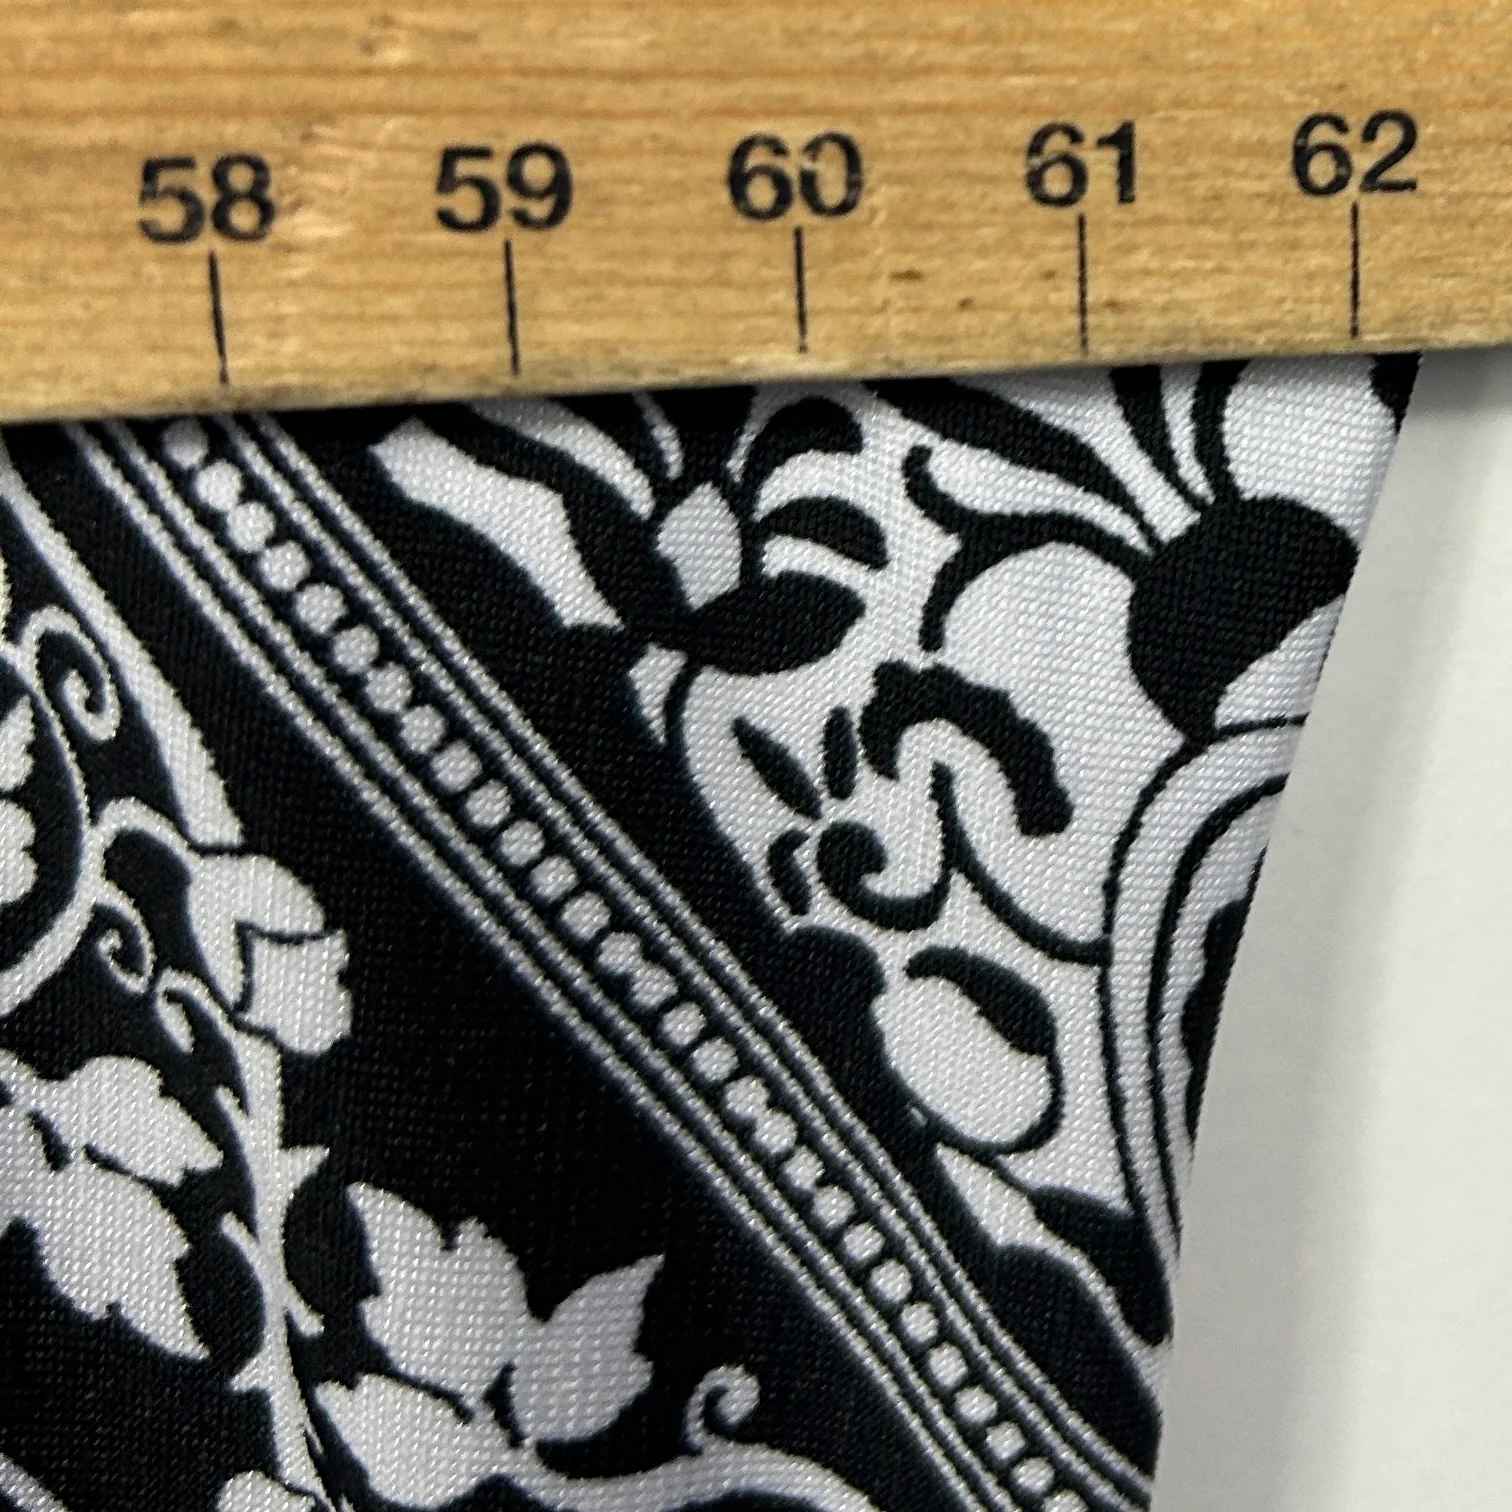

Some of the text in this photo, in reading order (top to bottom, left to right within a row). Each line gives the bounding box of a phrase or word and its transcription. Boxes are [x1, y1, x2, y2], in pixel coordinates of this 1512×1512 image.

[138, 152, 277, 245] 58
[435, 141, 574, 233] 59
[725, 132, 865, 222] 60
[1024, 121, 1136, 208] 61
[1290, 109, 1418, 197] 62
